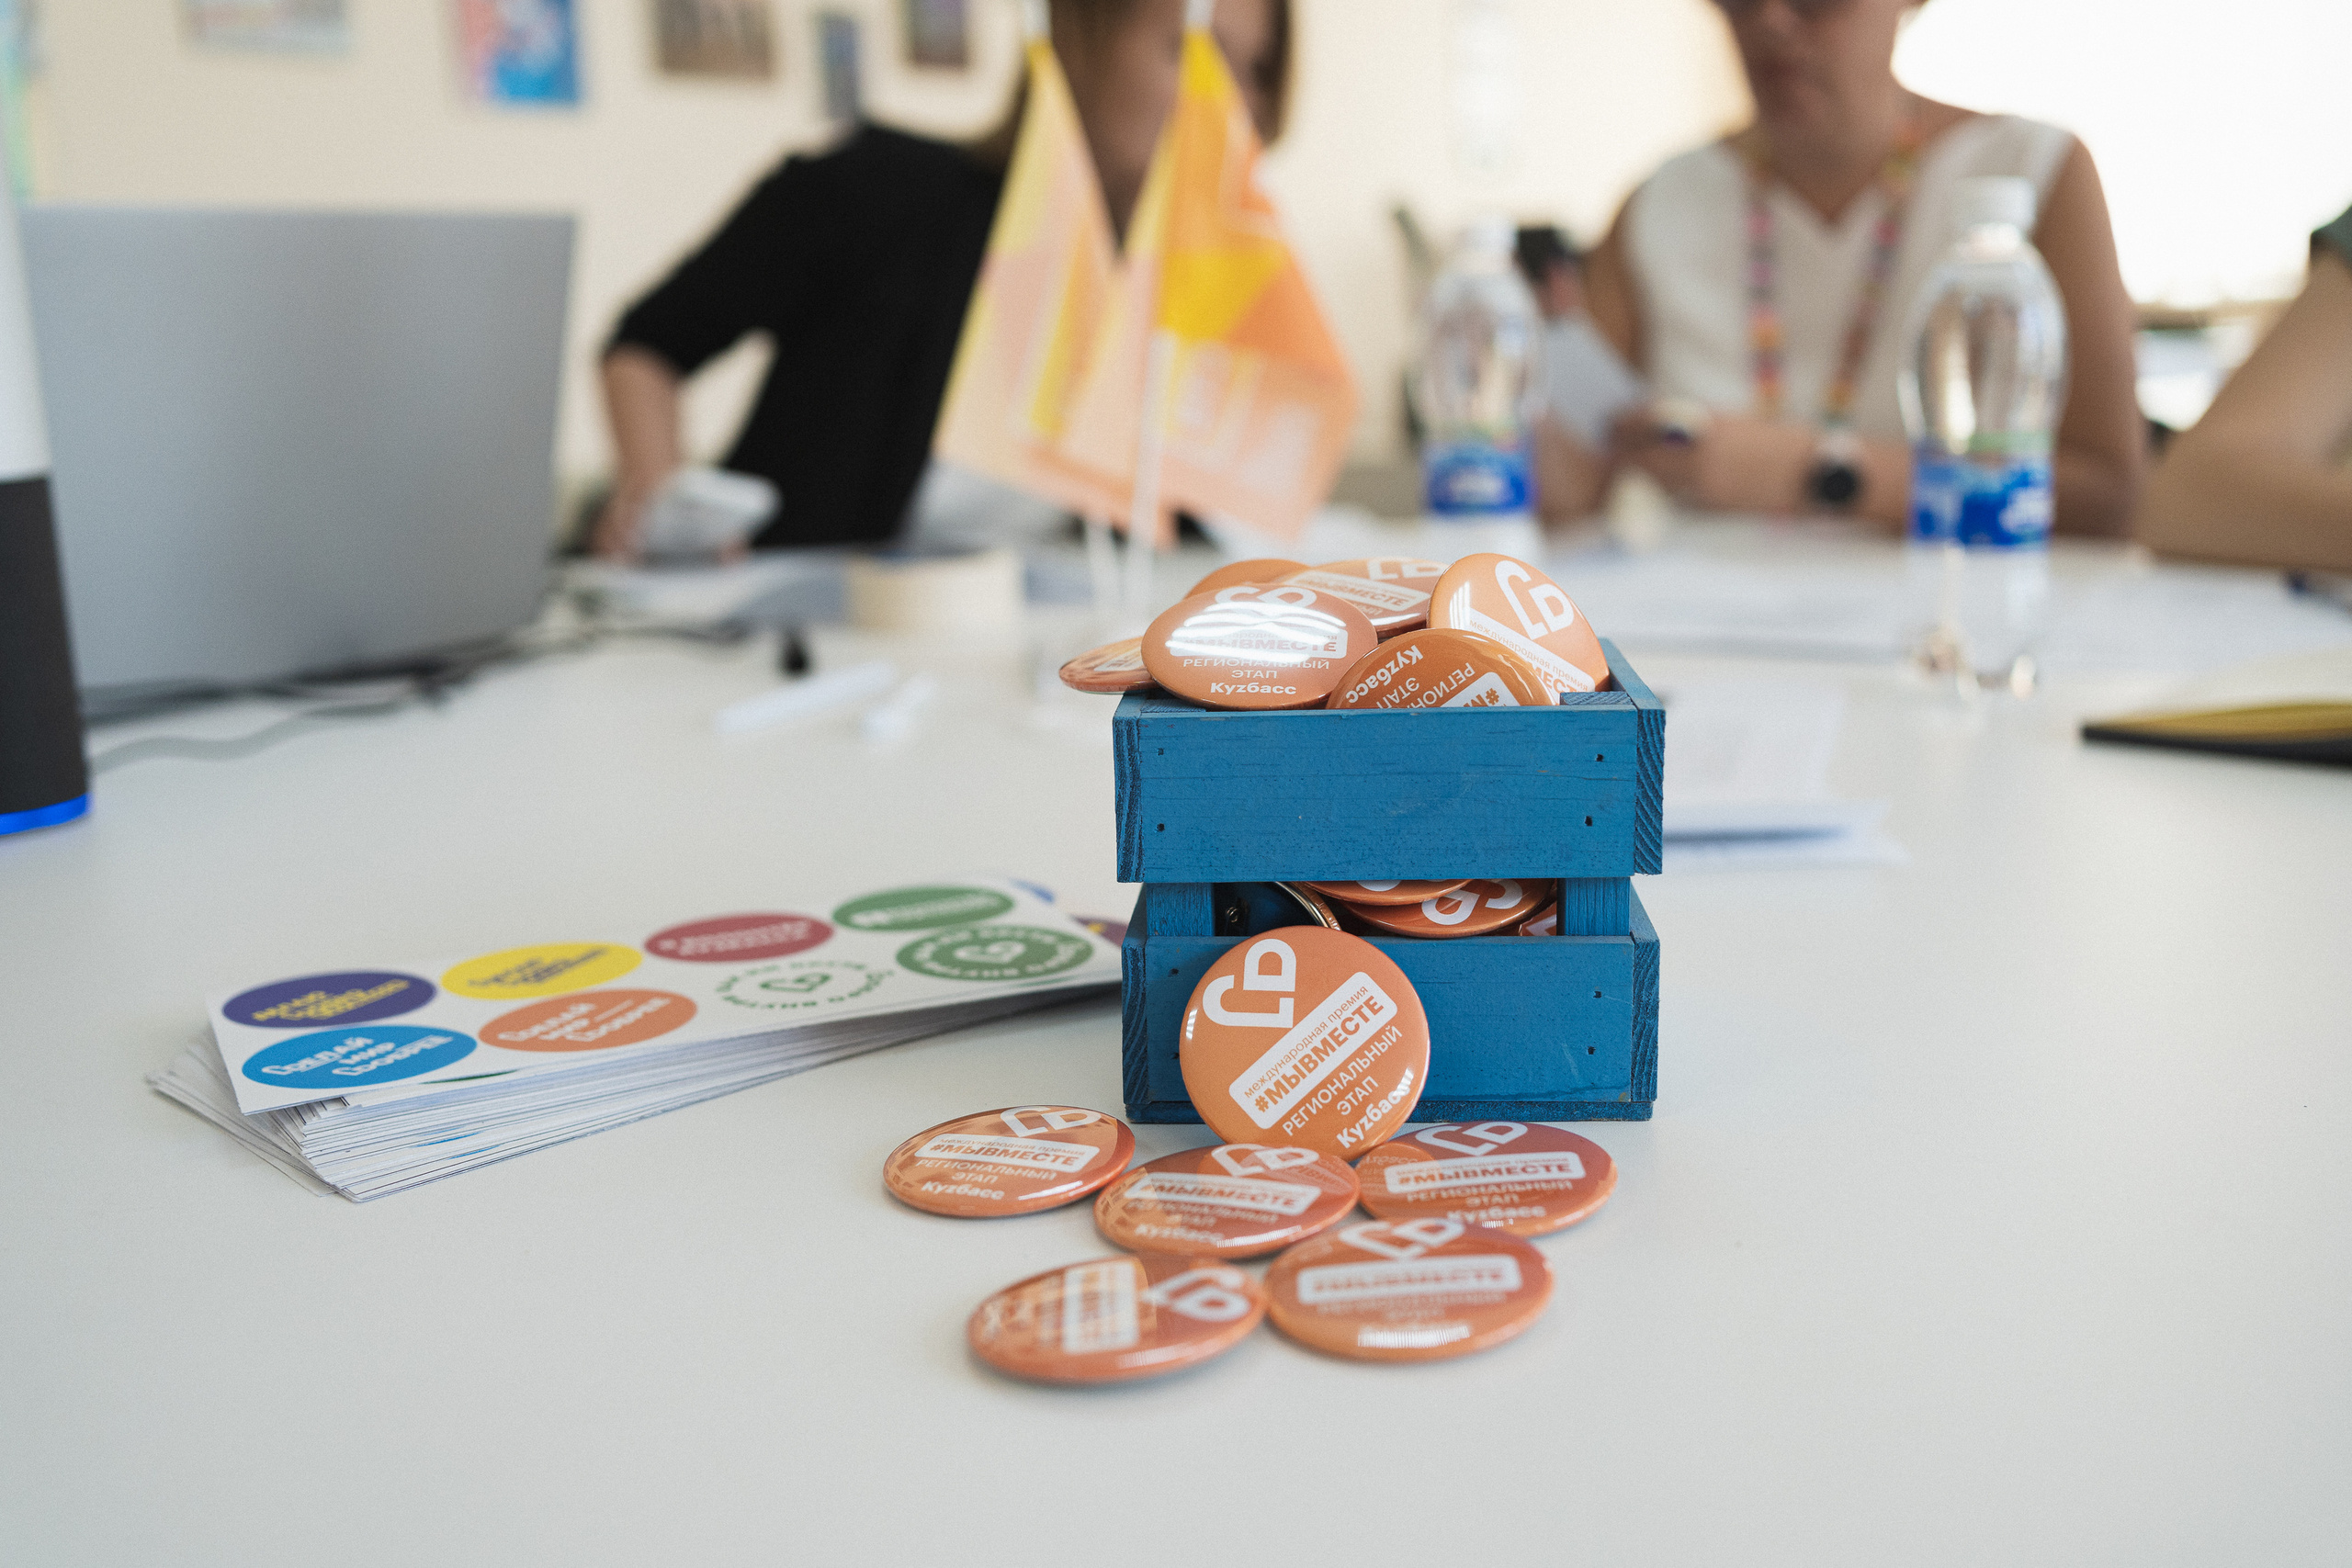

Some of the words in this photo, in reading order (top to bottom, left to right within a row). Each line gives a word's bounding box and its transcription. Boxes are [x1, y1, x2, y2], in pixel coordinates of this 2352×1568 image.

[1182, 659, 1330, 670] РЕГИОНАЛЬНЫЙ
[1469, 620, 1551, 670] международная
[1553, 665, 1589, 692] премия
[1231, 670, 1278, 679] ЭТАП
[1244, 1021, 1329, 1099] международная
[1329, 986, 1369, 1024] премия
[1254, 995, 1385, 1113] #МЫВМЕСТЕ
[1282, 1025, 1403, 1136] РЕГИОНАЛЬНЫЙ
[1337, 1076, 1379, 1115] ЭТАП
[930, 1143, 1080, 1167] #МЫВМЕСТЕ
[939, 1137, 1035, 1150] международная
[915, 1157, 1057, 1181] РЕГИОНАЛЬНЫЙ
[951, 1170, 999, 1185] ЭТАП
